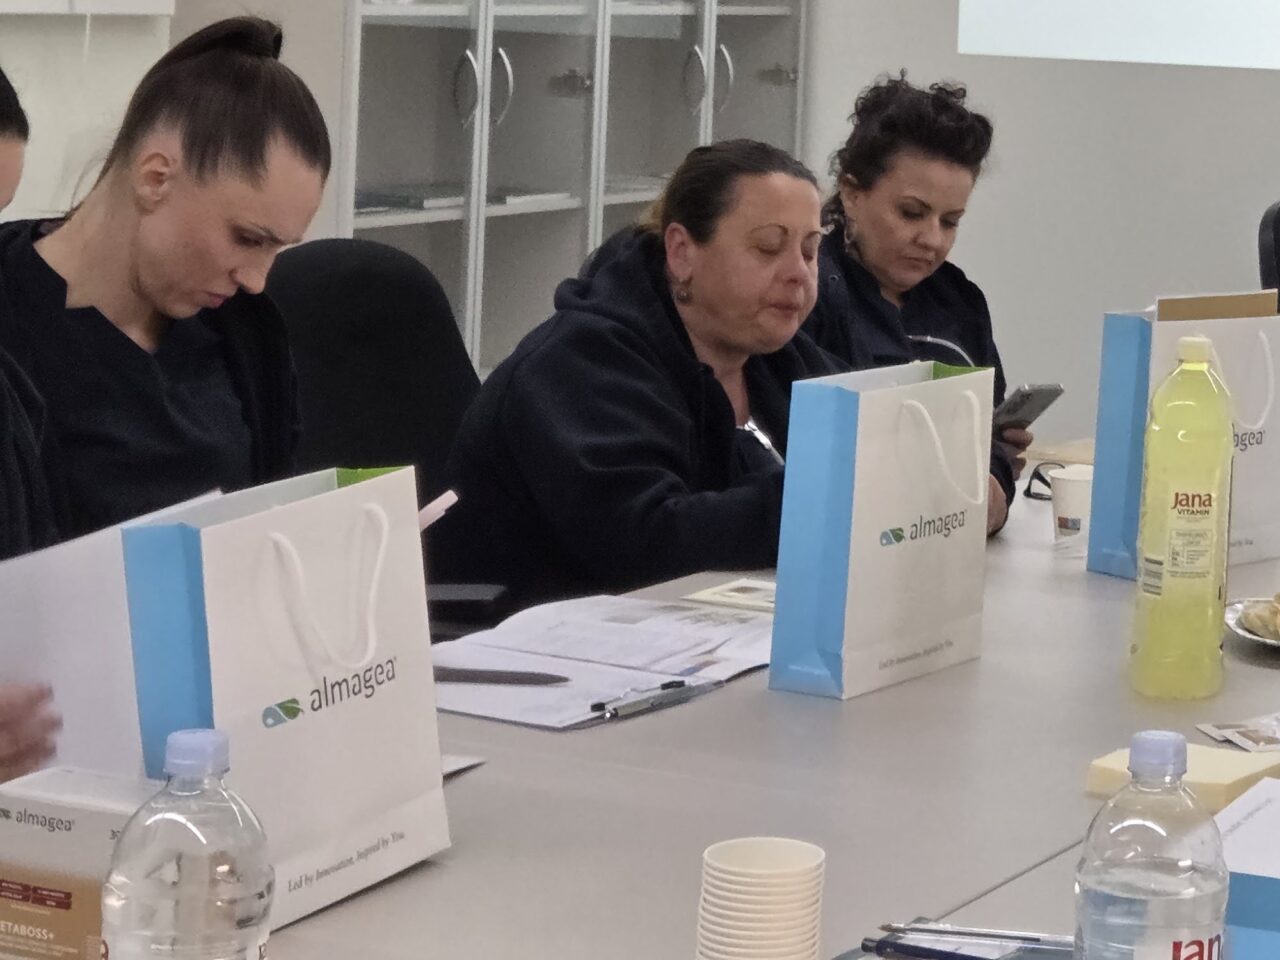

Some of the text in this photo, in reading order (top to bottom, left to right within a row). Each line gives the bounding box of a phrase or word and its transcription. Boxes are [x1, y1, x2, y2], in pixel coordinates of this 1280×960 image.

[1232, 430, 1264, 452] agea
[1170, 492, 1213, 510] Jana
[909, 512, 966, 541] almagea
[310, 656, 397, 713] almagea
[15, 807, 74, 833] almagea
[0, 920, 56, 941] ETABOSS+
